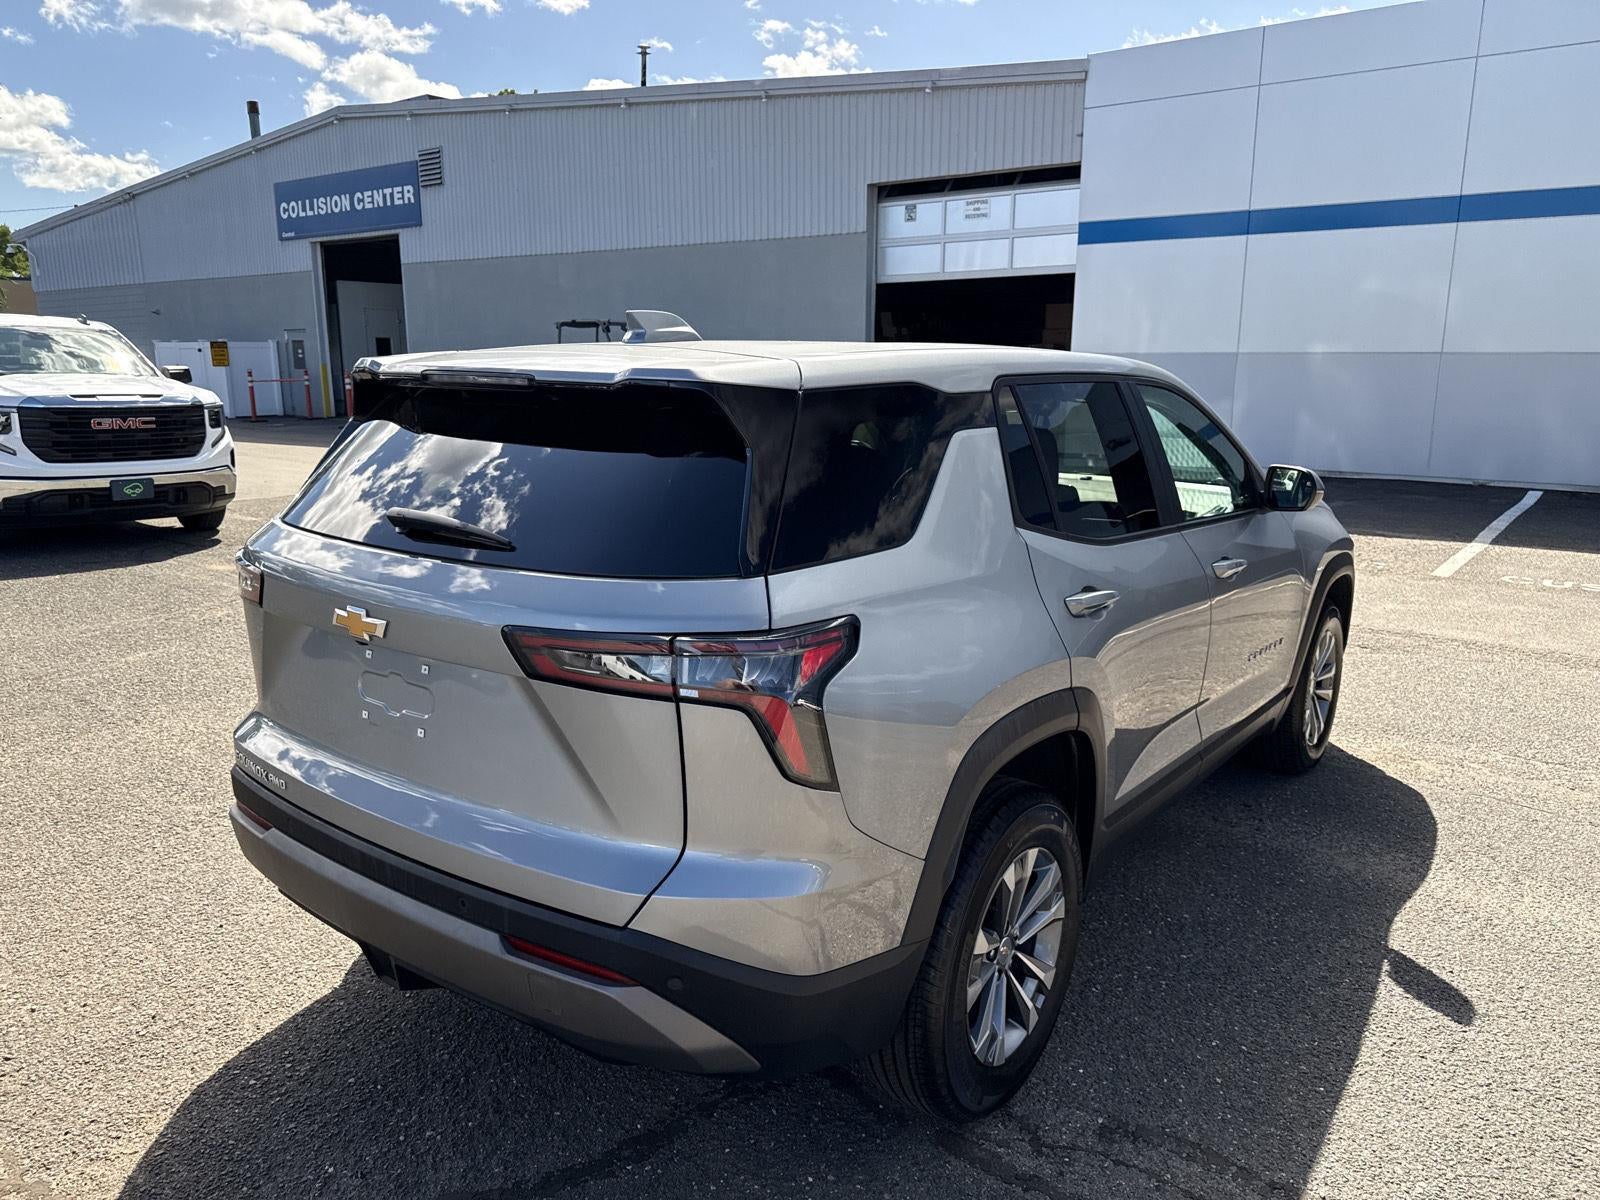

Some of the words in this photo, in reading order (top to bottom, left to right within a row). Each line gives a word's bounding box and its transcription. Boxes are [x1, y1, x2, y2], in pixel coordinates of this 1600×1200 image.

[279, 194, 350, 219] COLLISION
[353, 185, 415, 210] CENTER
[91, 417, 156, 430] GMC
